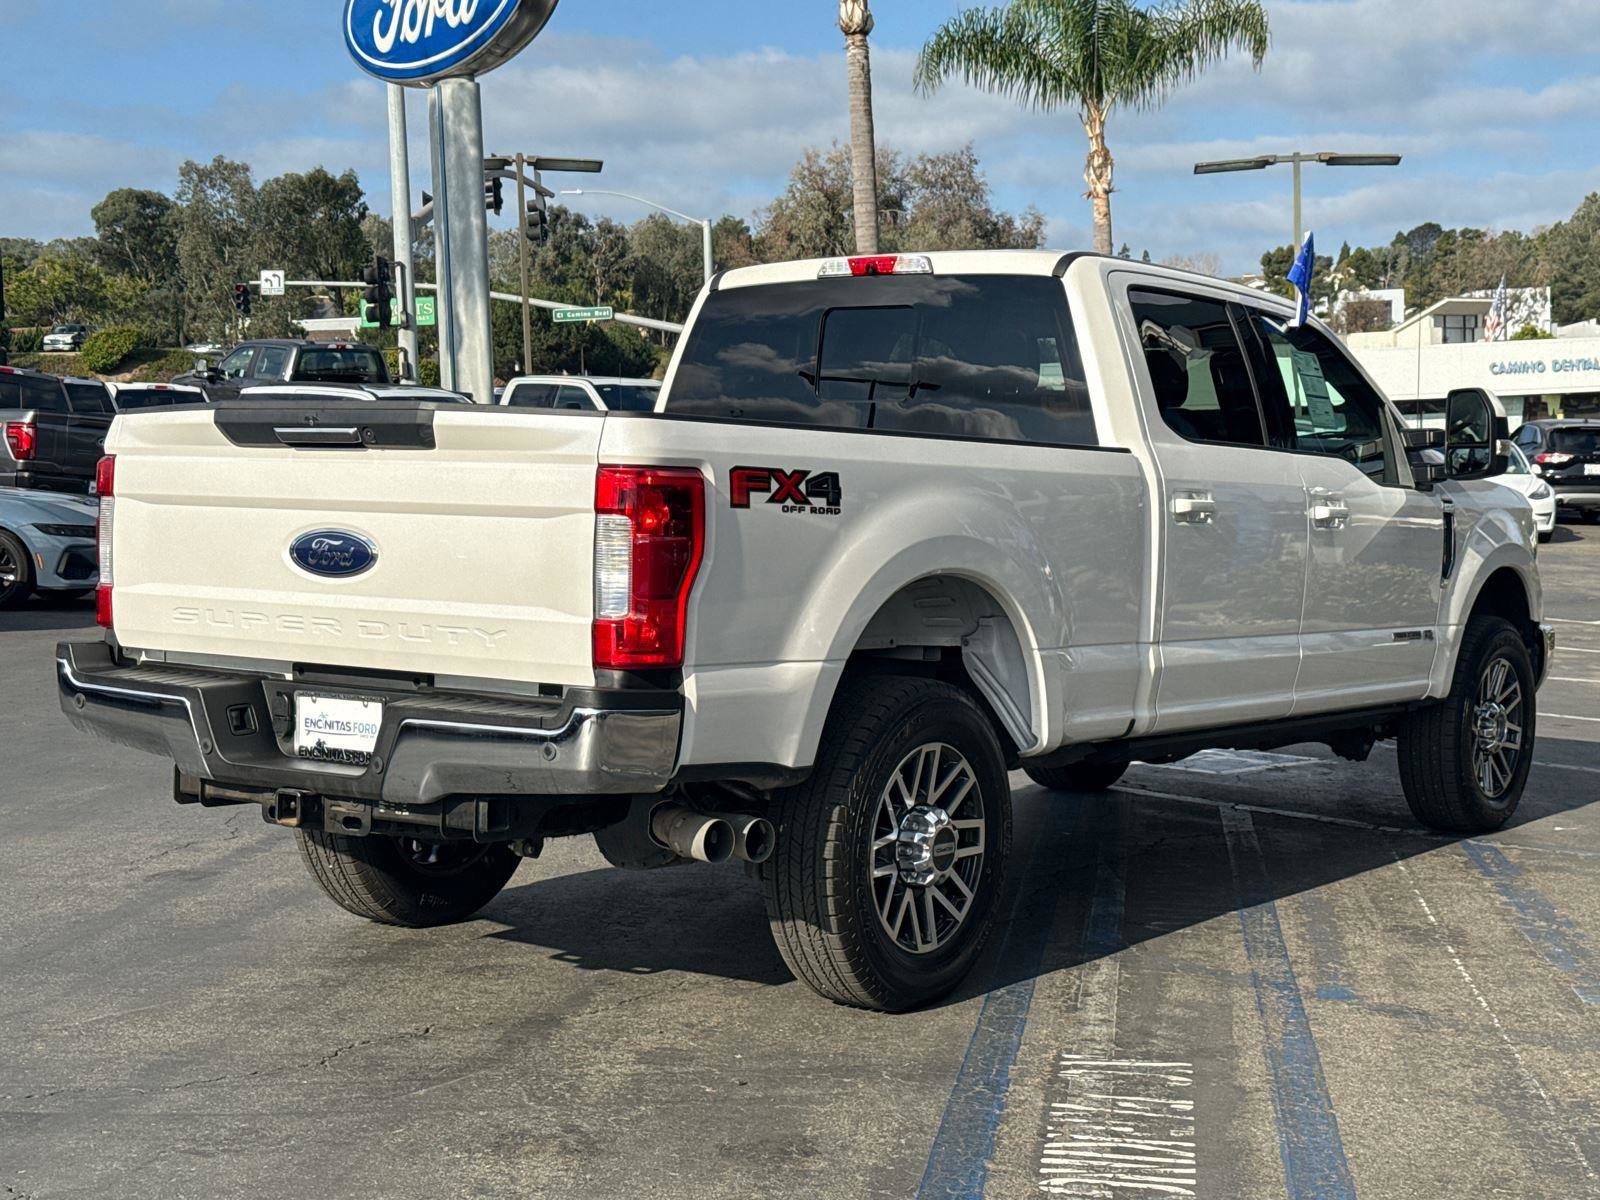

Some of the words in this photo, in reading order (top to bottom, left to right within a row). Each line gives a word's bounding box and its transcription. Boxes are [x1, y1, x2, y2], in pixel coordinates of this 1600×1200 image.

[1489, 360, 1546, 375] CAMINO
[1551, 357, 1600, 373] DENTAL
[729, 465, 842, 509] FX4
[782, 505, 806, 514] OFF
[810, 506, 841, 515] ROAD
[308, 538, 355, 567] Ford
[172, 606, 344, 636] SUPER
[357, 619, 507, 648] DUTY
[353, 722, 378, 735] FORD
[352, 750, 374, 764] FOR
